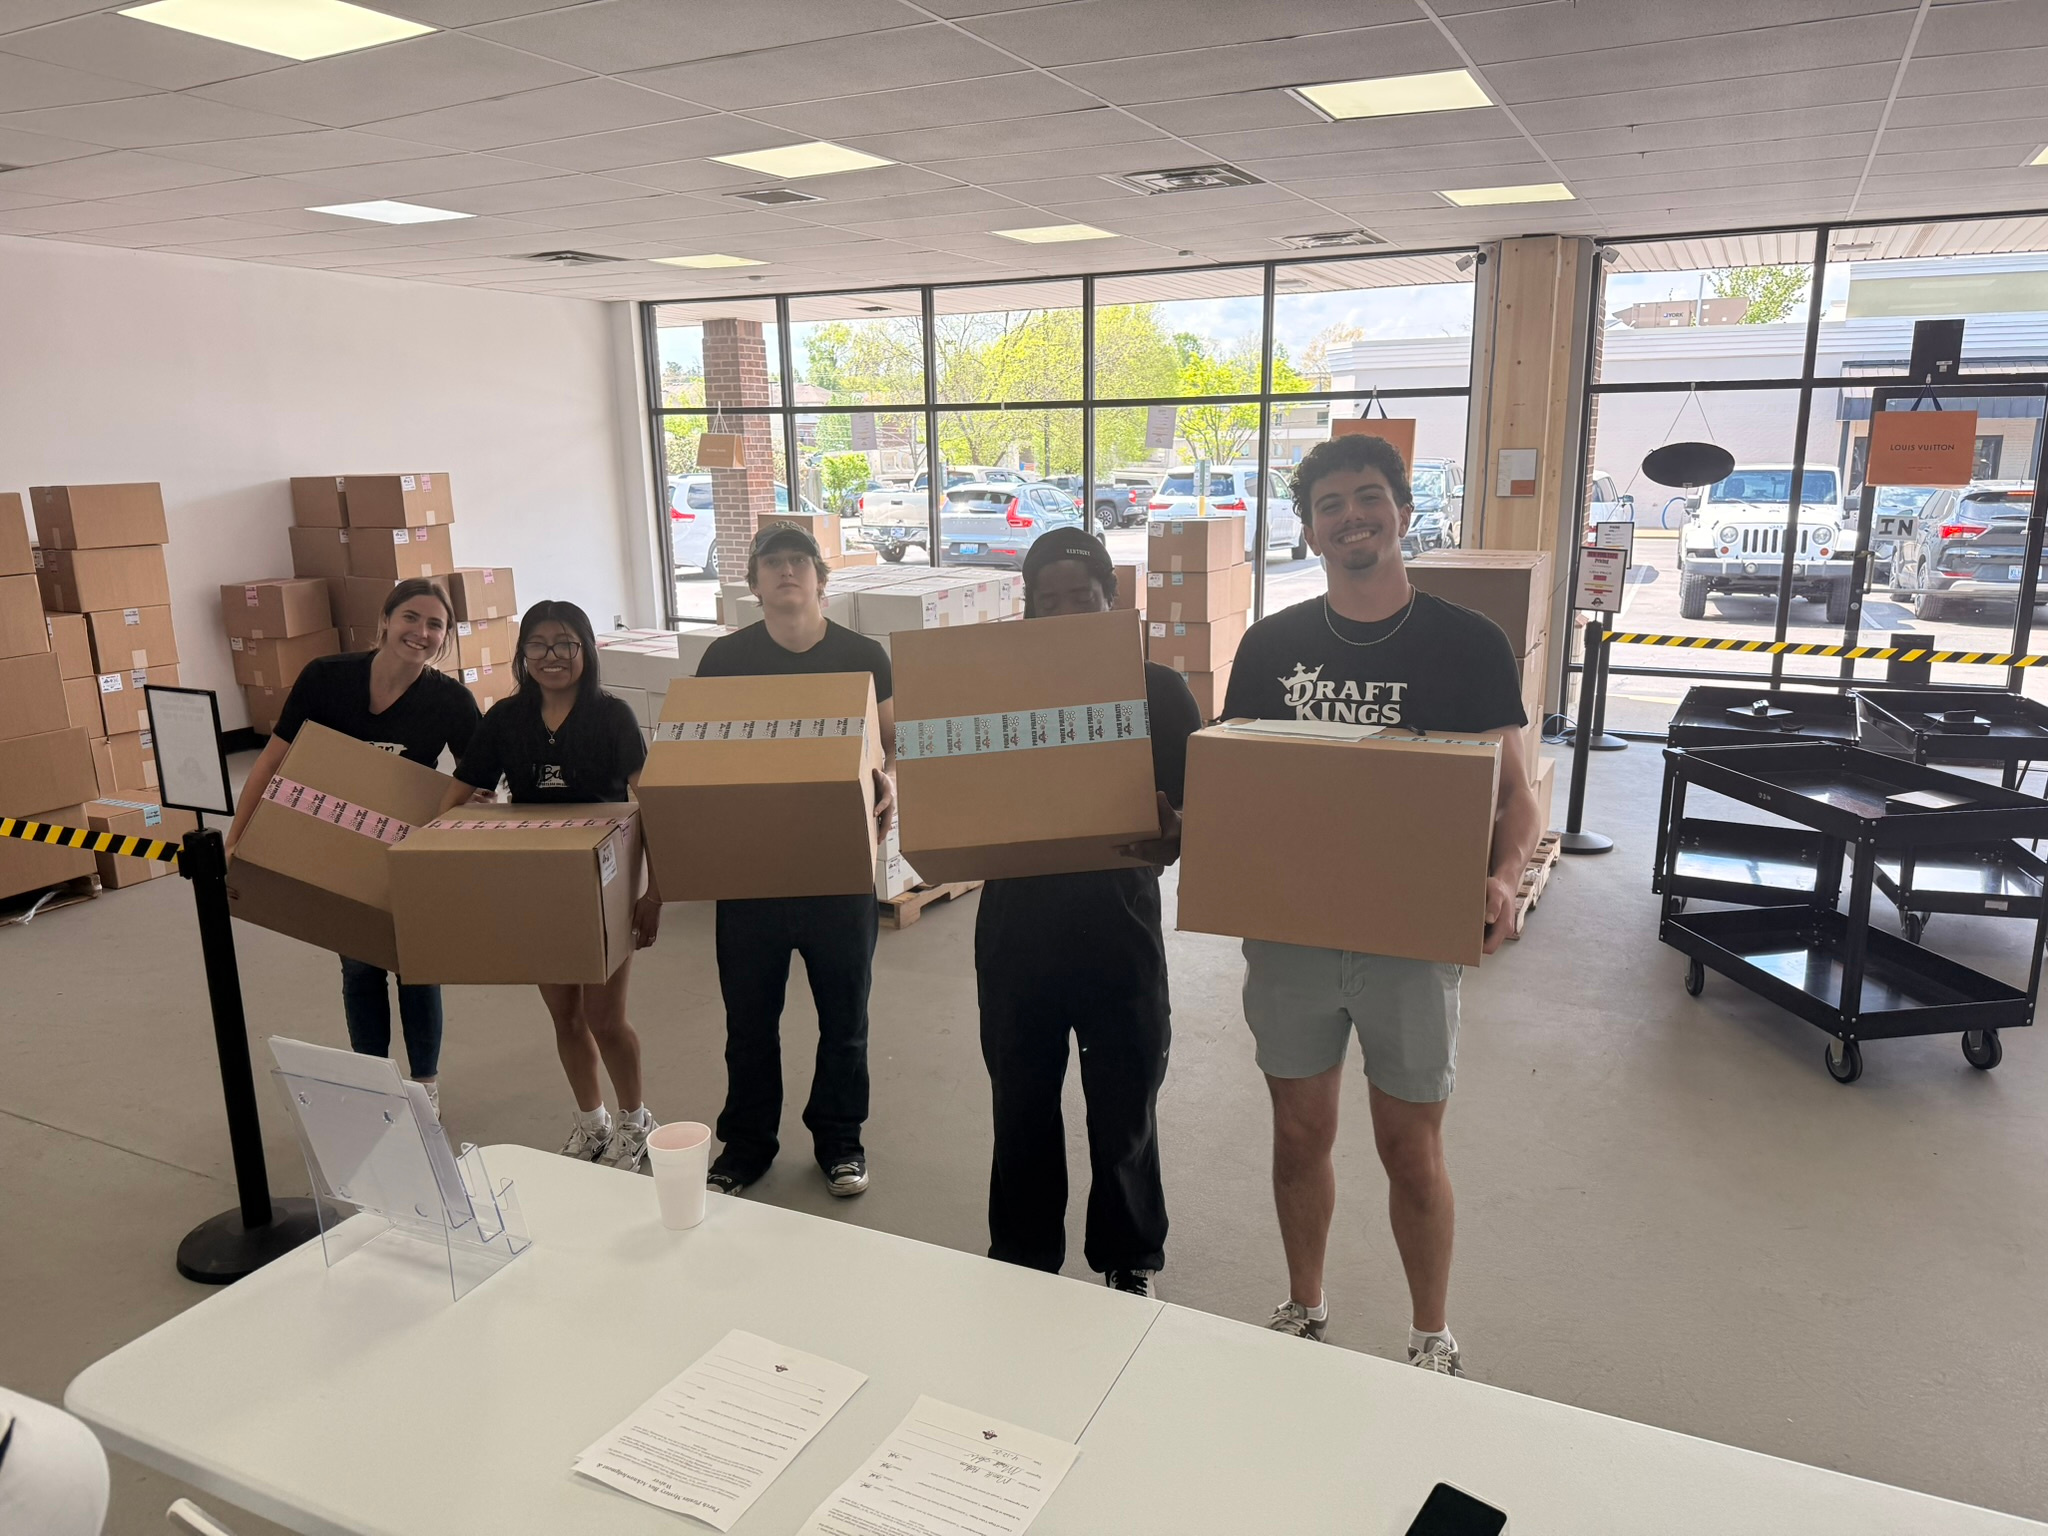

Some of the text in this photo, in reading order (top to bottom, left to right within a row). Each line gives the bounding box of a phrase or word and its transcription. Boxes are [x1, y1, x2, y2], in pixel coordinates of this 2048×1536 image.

[1878, 518, 1914, 537] IN
[1284, 680, 1408, 707] DRAFT
[1295, 699, 1402, 725] KINGS
[652, 1478, 672, 1489] Waiver
[660, 1489, 681, 1500] Mystery
